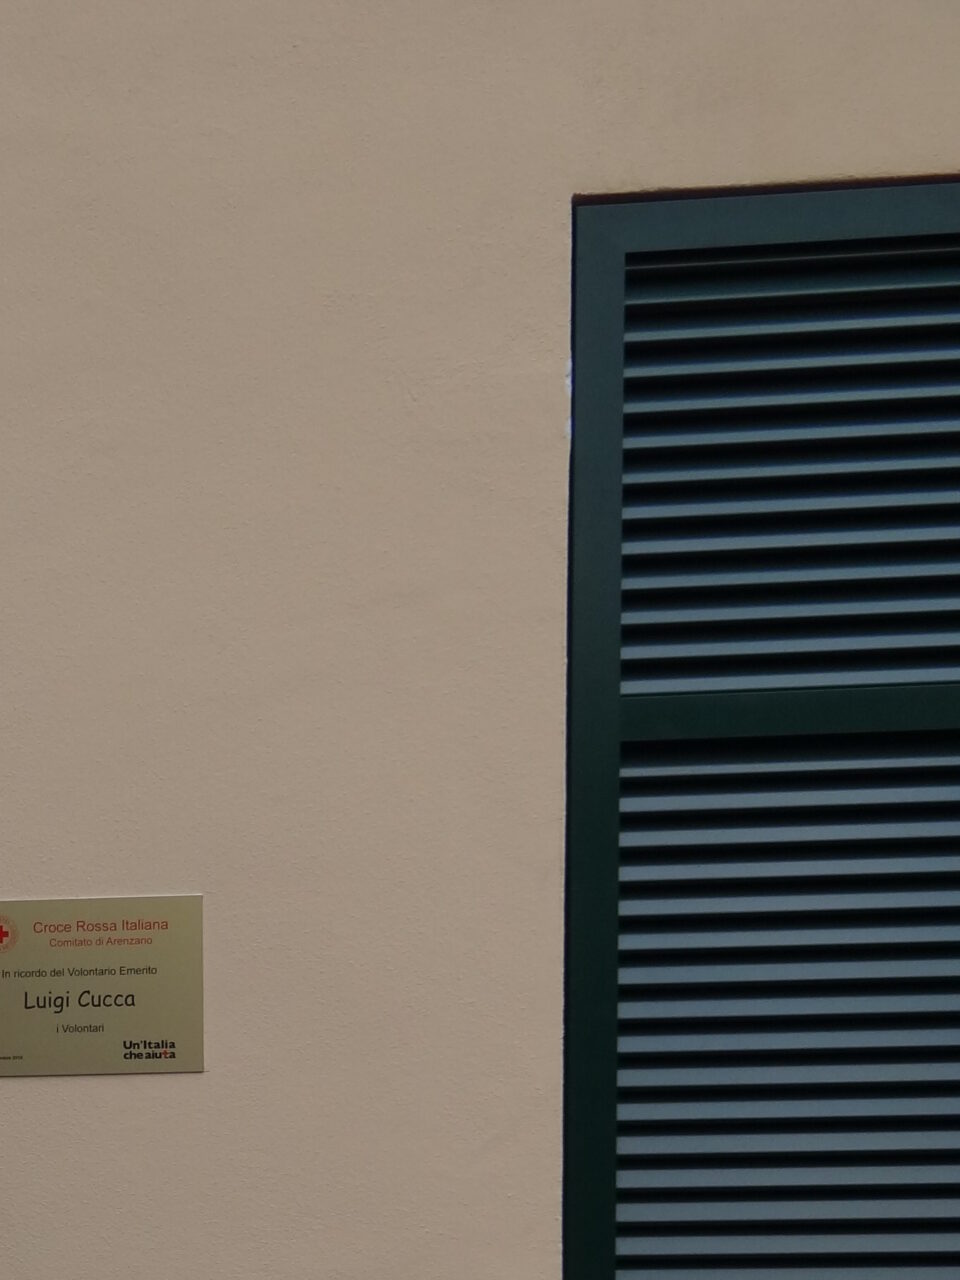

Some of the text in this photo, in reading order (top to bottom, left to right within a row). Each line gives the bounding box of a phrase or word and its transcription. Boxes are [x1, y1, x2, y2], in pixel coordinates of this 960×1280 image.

[33, 919, 168, 934] Croce Rossa Italiana
[49, 937, 152, 948] Comitato di Arenzano
[2, 966, 157, 978] In ricordo del Volontario Emerito
[25, 990, 135, 1013] Luigi Cucca
[62, 1024, 104, 1033] Volontari
[123, 1040, 176, 1050] Un'Italia
[123, 1050, 176, 1060] che aiuta
